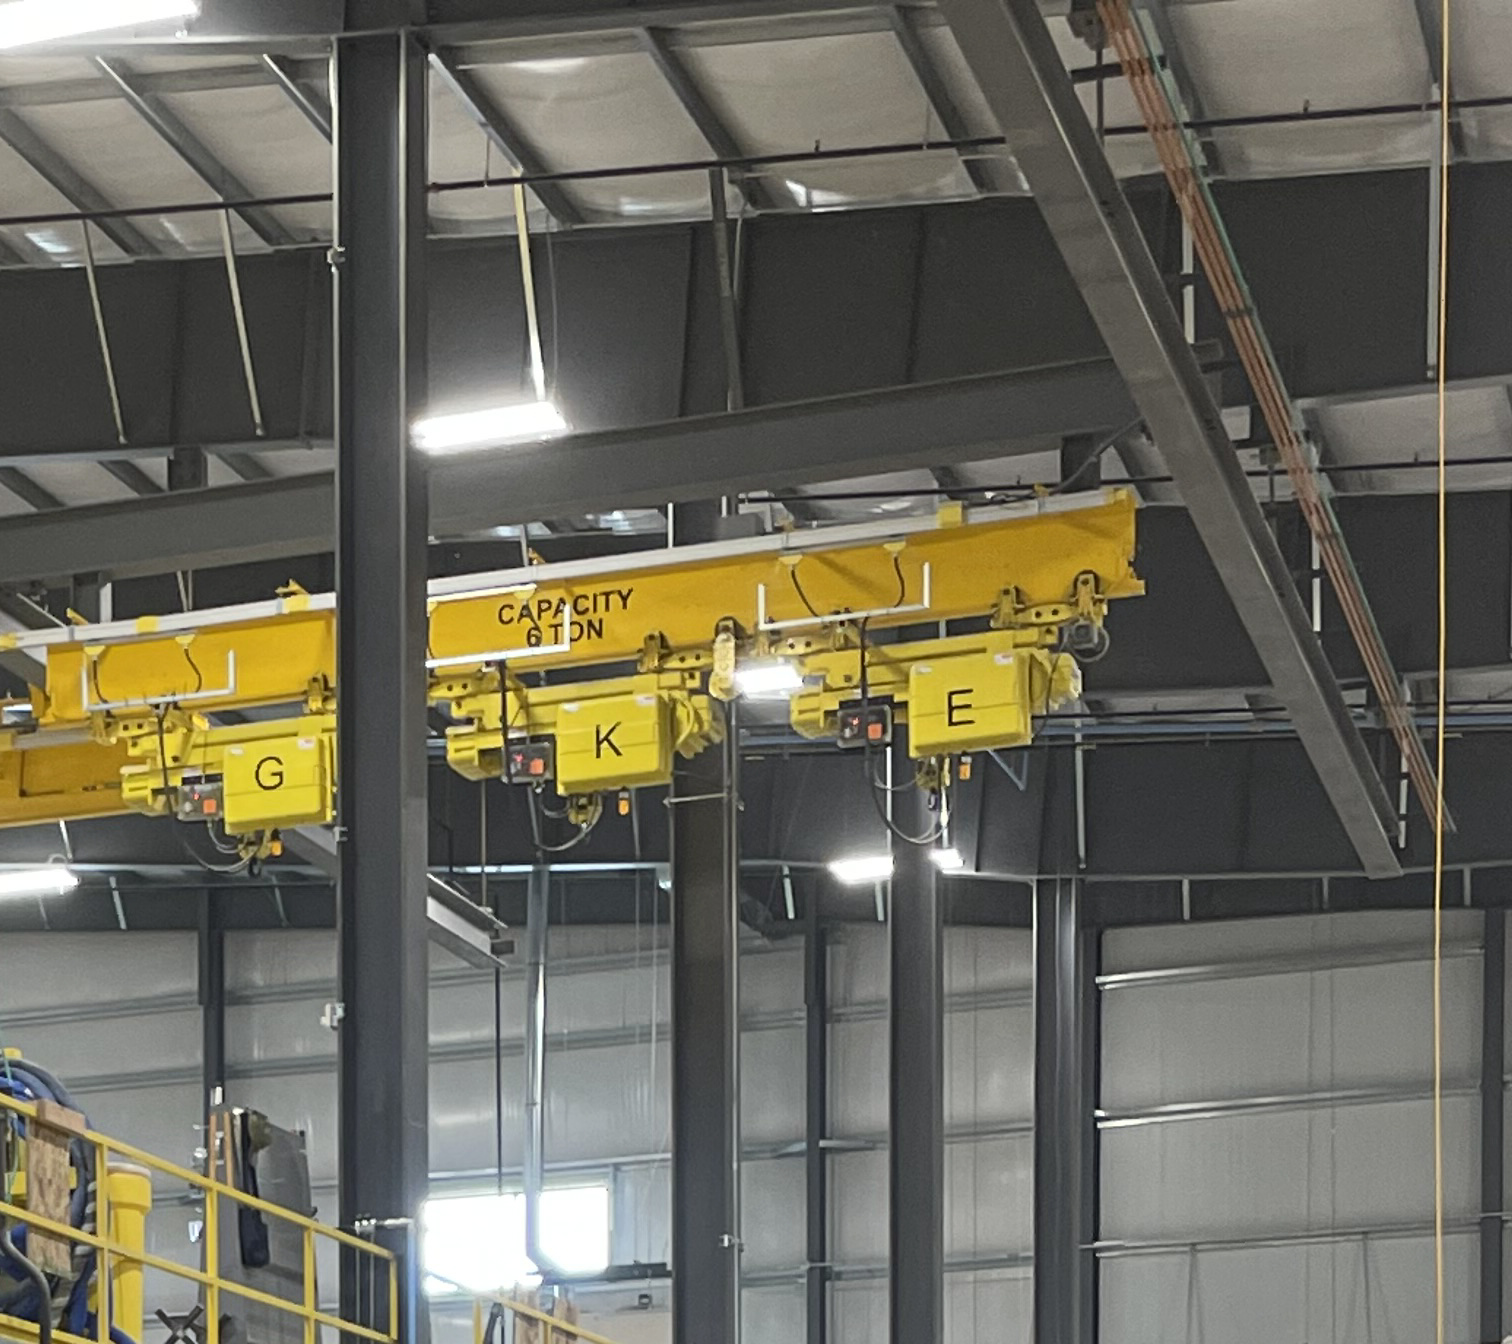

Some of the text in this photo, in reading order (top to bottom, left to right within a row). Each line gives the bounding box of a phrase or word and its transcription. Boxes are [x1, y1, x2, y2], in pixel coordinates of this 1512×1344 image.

[498, 588, 634, 625] CAPACITY
[526, 618, 603, 648] 6 TON
[948, 688, 976, 727] E
[595, 721, 623, 759] K
[254, 756, 284, 791] G
